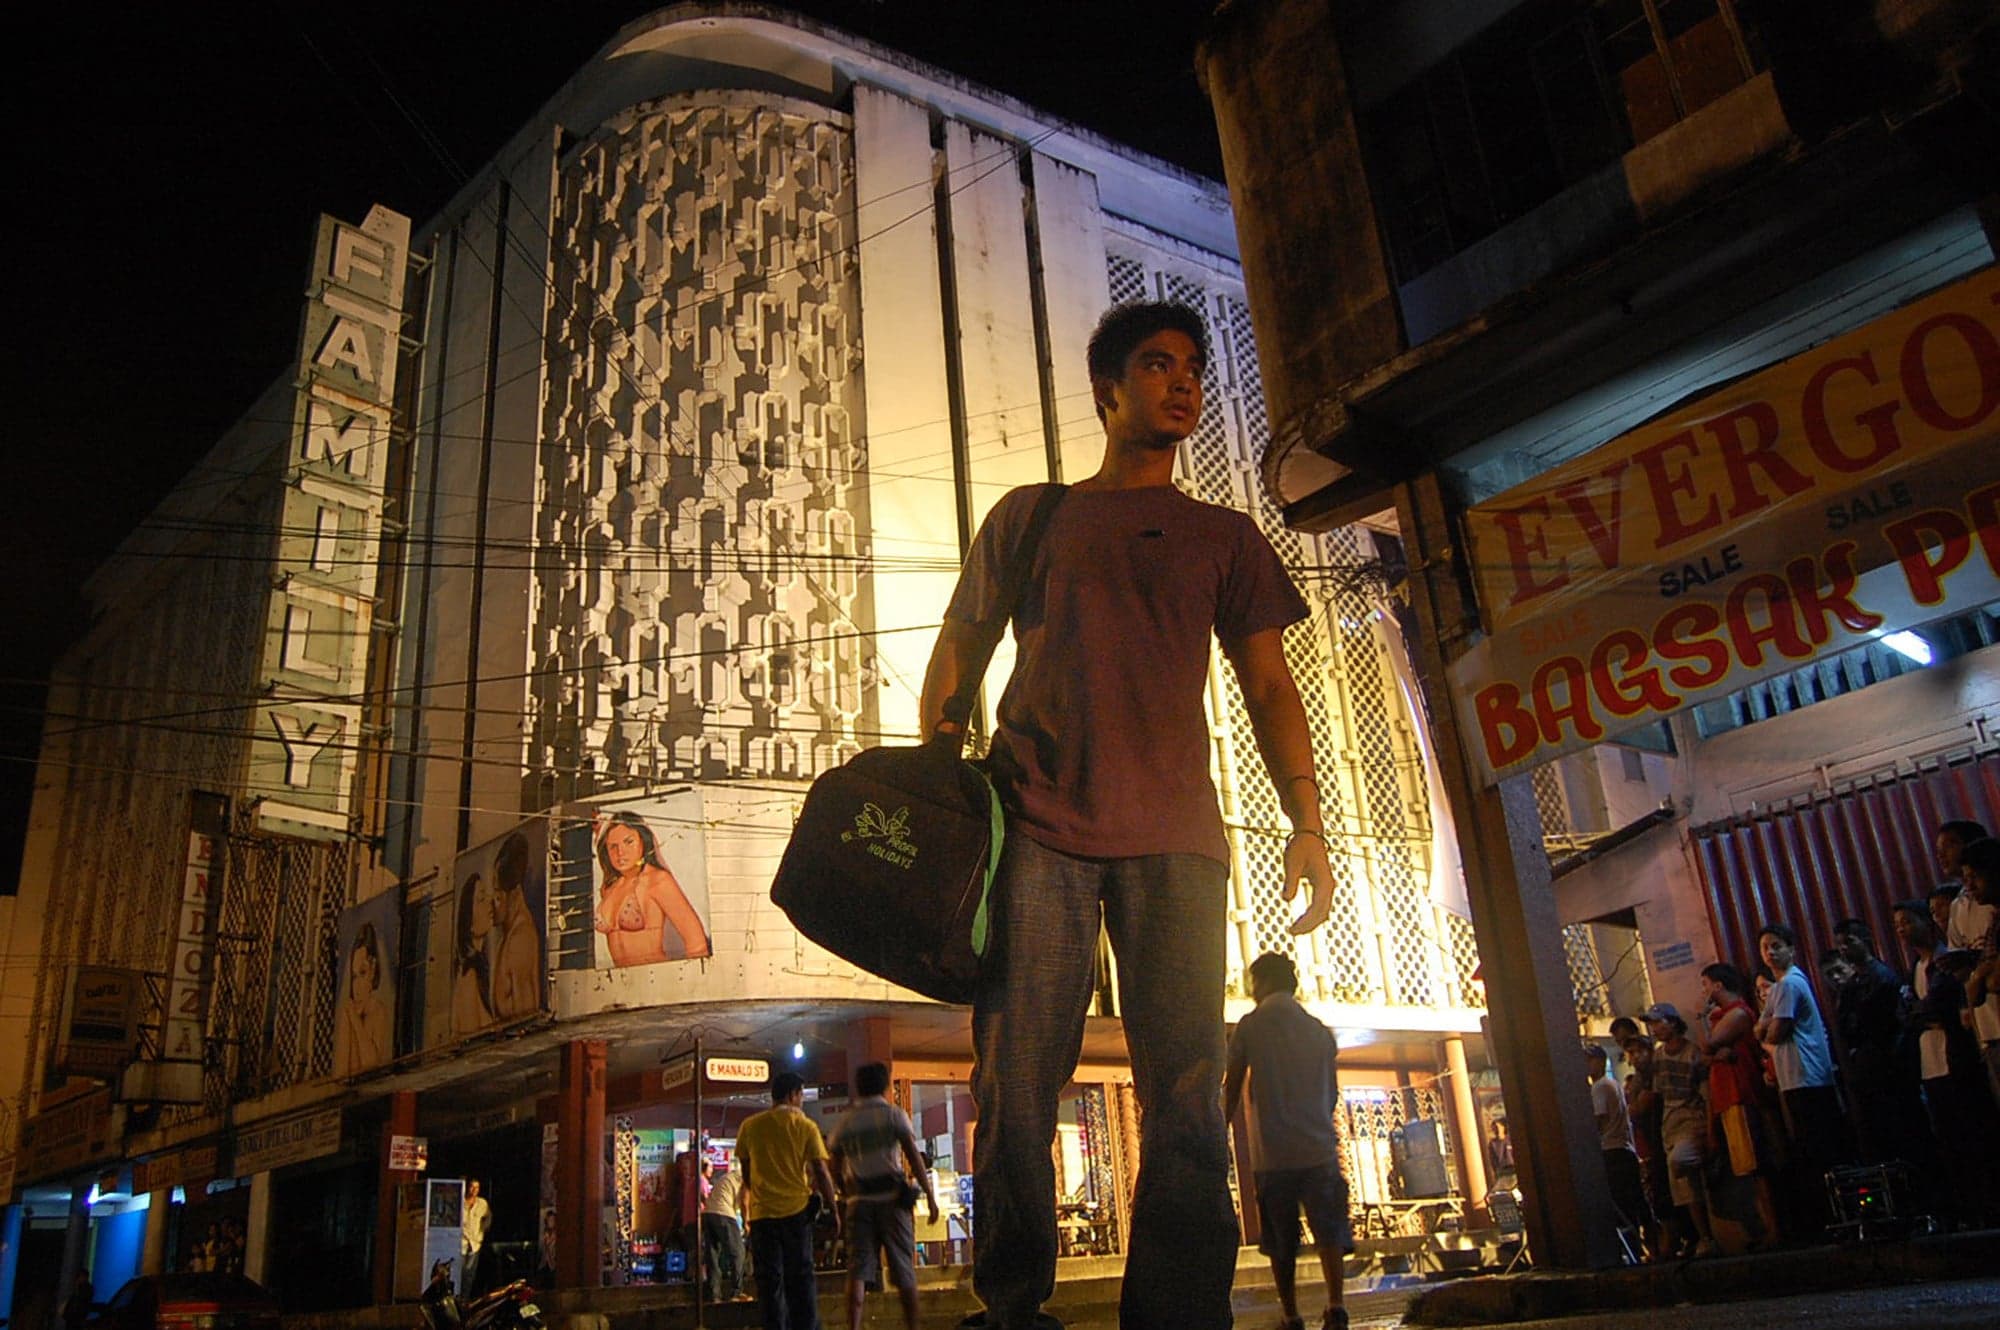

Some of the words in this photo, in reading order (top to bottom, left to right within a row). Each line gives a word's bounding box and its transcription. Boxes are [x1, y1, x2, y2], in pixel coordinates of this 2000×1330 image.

[1494, 292, 2000, 606] EVERGO
[270, 223, 391, 788] FAMILY
[1824, 479, 1914, 531] SALE
[1659, 544, 1744, 598] SALE
[1475, 541, 1884, 770] BAGSAK
[1519, 604, 1593, 656] SALE
[867, 843, 913, 869] HOLIDAYS
[718, 1063, 752, 1077] MANALO
